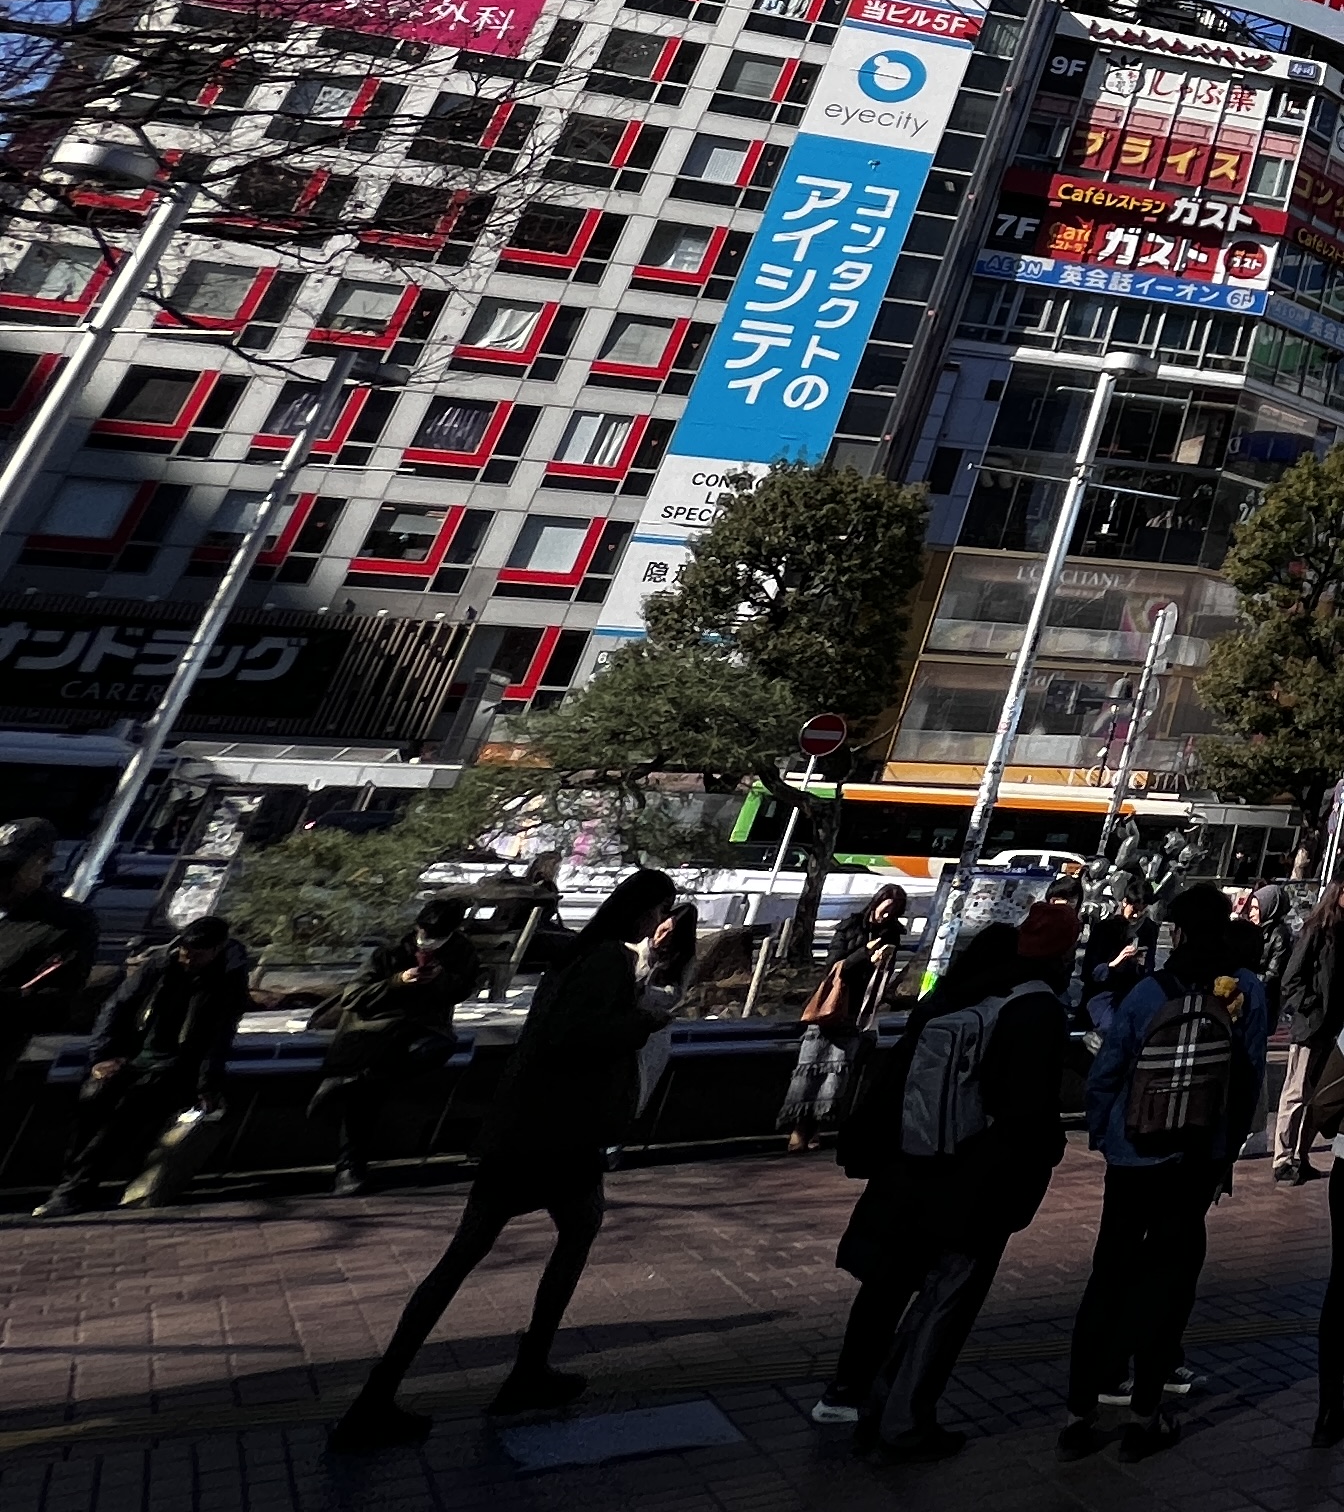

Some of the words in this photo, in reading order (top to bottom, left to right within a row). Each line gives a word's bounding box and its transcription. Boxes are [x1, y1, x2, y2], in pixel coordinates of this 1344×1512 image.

[861, 0, 970, 37] 当ビル5F
[1049, 56, 1086, 80] 9F
[1153, 70, 1258, 112] しゃぶ葉
[824, 101, 930, 140] eyecity
[996, 213, 1040, 240] 7F
[1168, 197, 1253, 232] ガスト
[1097, 227, 1209, 271] ガスト
[724, 174, 853, 406] アイシティ
[782, 184, 899, 411] コンタクトの
[1059, 264, 1221, 304] 英会話イーオン
